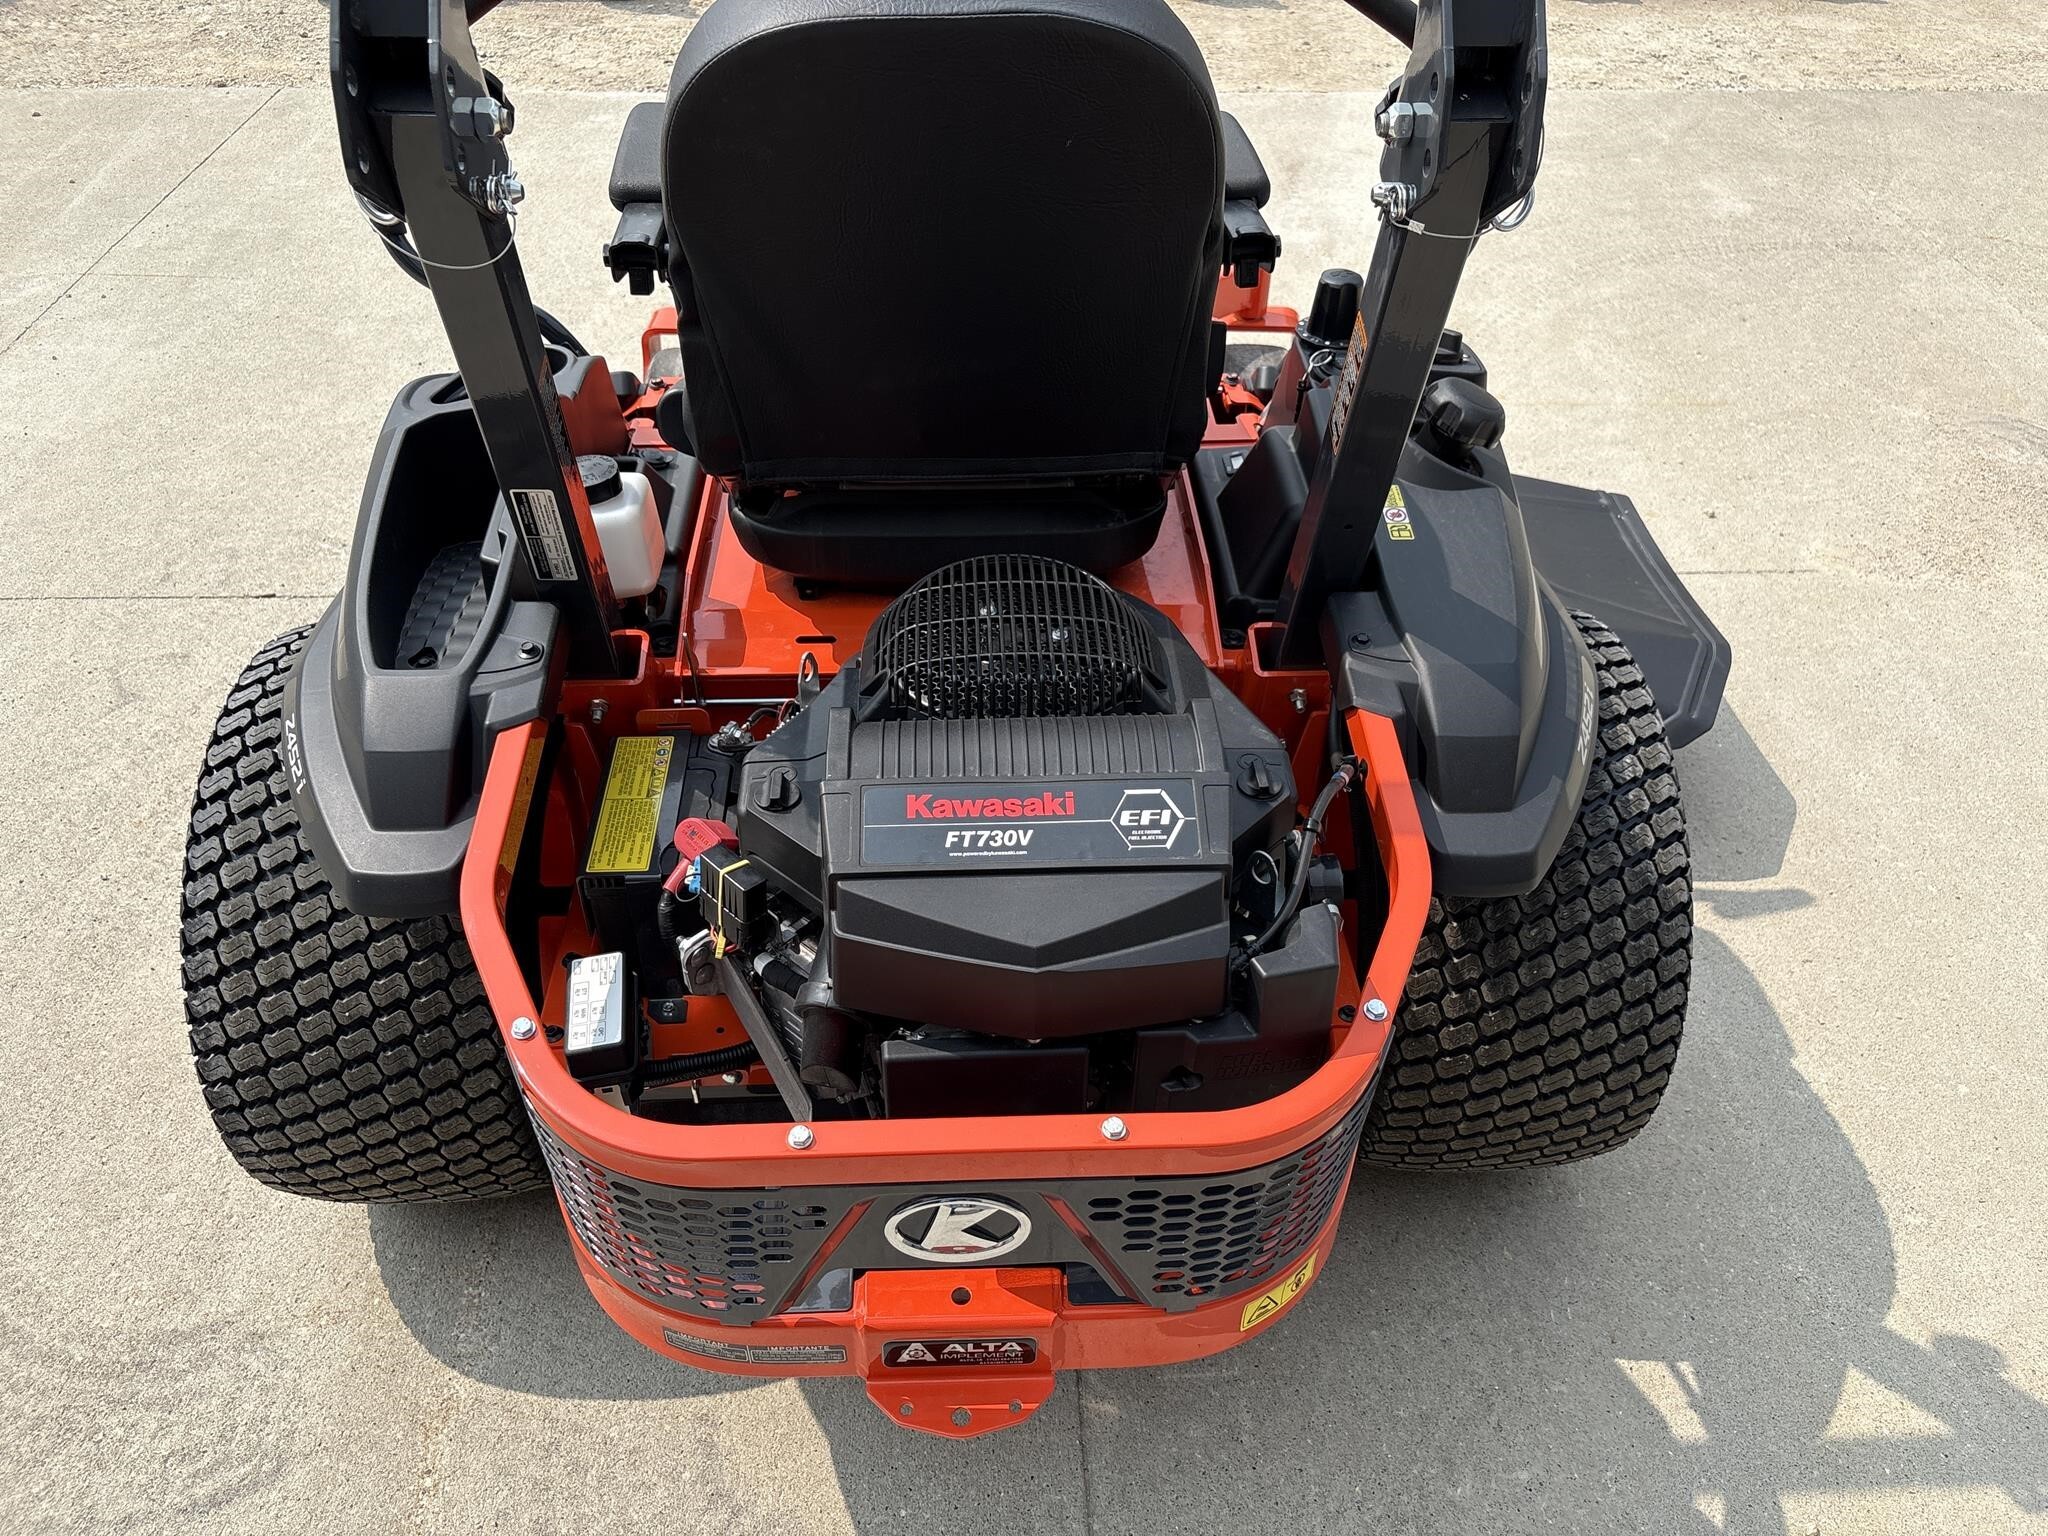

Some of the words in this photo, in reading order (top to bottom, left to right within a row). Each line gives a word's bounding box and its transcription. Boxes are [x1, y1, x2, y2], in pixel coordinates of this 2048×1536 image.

[1577, 681, 1594, 766] Z452i
[285, 713, 306, 795] Z452i
[906, 791, 1076, 819] Kawasaki
[1119, 809, 1172, 826] EFI
[945, 829, 1034, 848] FT730V
[677, 1331, 729, 1348] IMPORTANT
[942, 1342, 1024, 1353] ALTA
